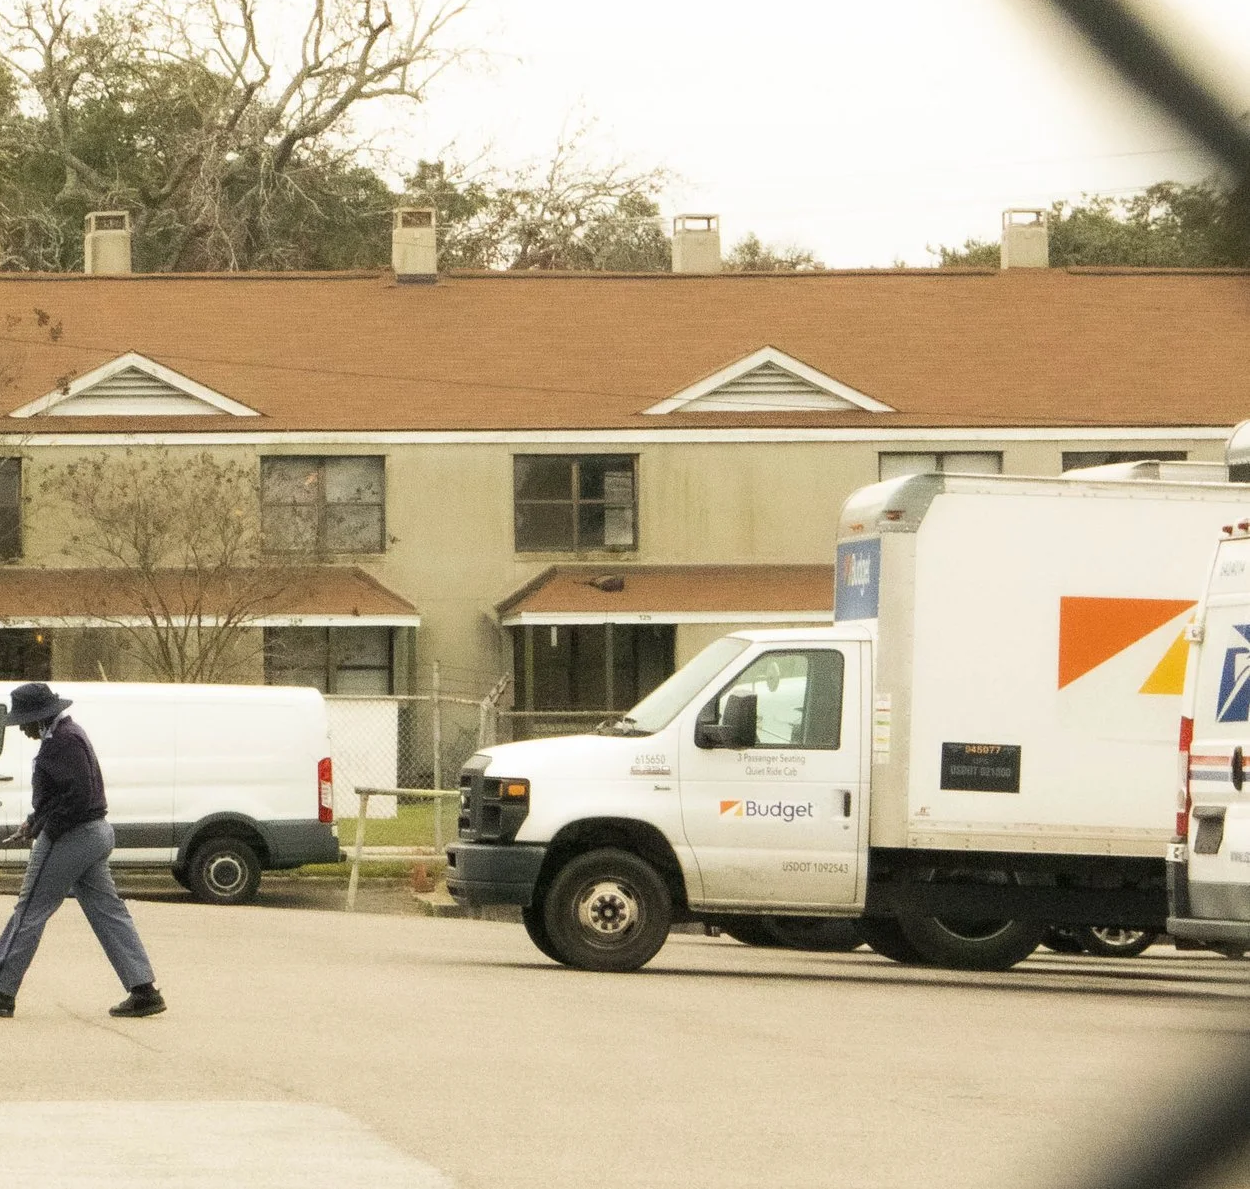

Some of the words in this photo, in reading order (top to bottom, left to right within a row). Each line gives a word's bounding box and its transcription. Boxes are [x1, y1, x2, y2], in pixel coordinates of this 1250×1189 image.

[744, 753, 778, 765] Passenger
[779, 753, 806, 766] Seating
[745, 766, 765, 777] Quiet
[766, 766, 782, 777] Ride
[783, 766, 798, 777] Cab
[746, 801, 813, 822] Budget
[782, 861, 812, 873] USDOT
